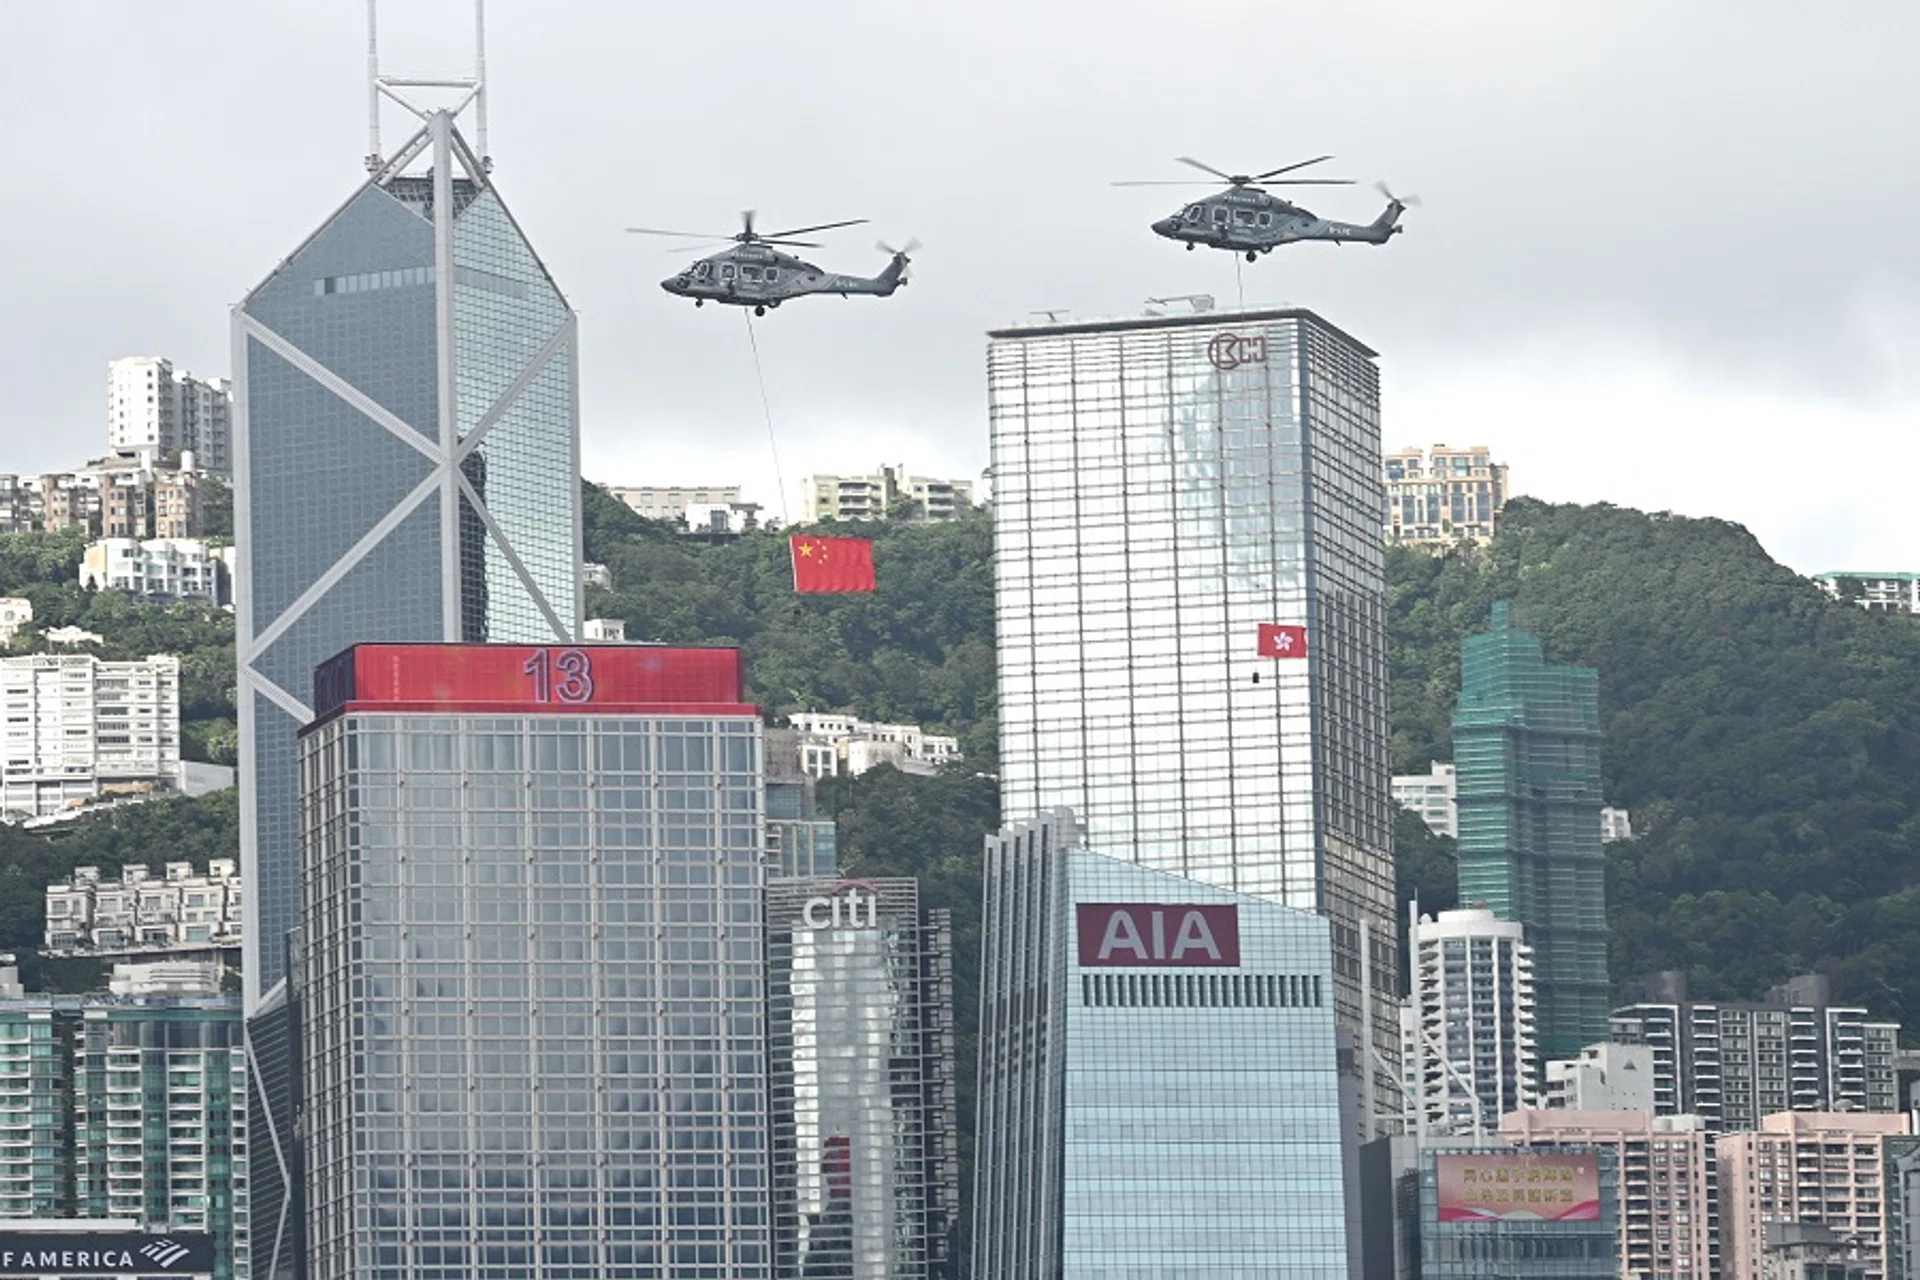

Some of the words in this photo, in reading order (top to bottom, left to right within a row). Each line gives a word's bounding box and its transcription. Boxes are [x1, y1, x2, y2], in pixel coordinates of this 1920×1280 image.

[523, 648, 594, 703] 13
[803, 887, 876, 929] citi
[1097, 910, 1222, 960] AIA
[21, 1252, 134, 1267] AMERICA
